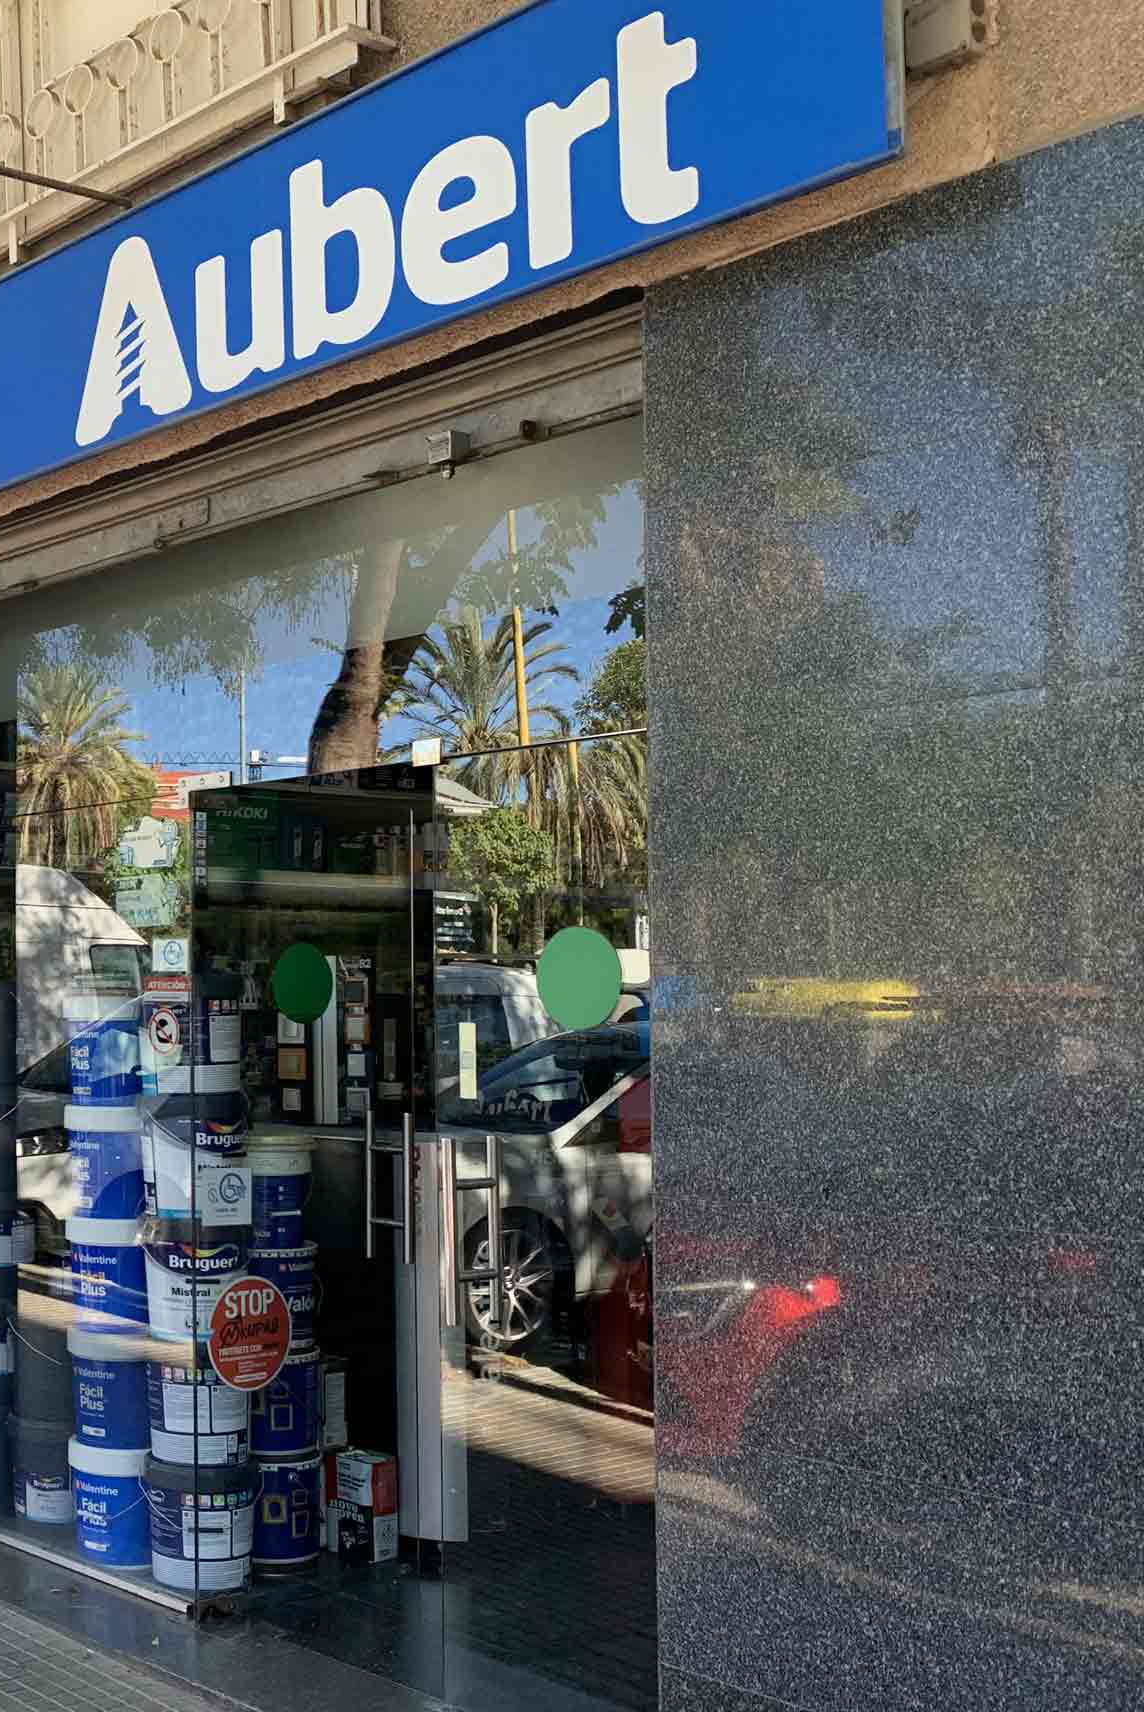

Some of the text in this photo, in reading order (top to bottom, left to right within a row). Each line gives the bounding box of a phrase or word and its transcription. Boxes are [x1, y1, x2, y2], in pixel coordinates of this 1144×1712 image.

[75, 10, 700, 448] Aubert
[195, 1132, 242, 1148] Brugue
[79, 1253, 118, 1265] Valentine
[168, 1254, 235, 1272] Bruguer
[80, 1282, 107, 1297] Plus
[224, 1287, 275, 1320] STOP
[79, 1382, 105, 1397] Fácil
[79, 1395, 106, 1411] Plus
[79, 1480, 119, 1496] Valentine
[81, 1497, 107, 1514] Fácil
